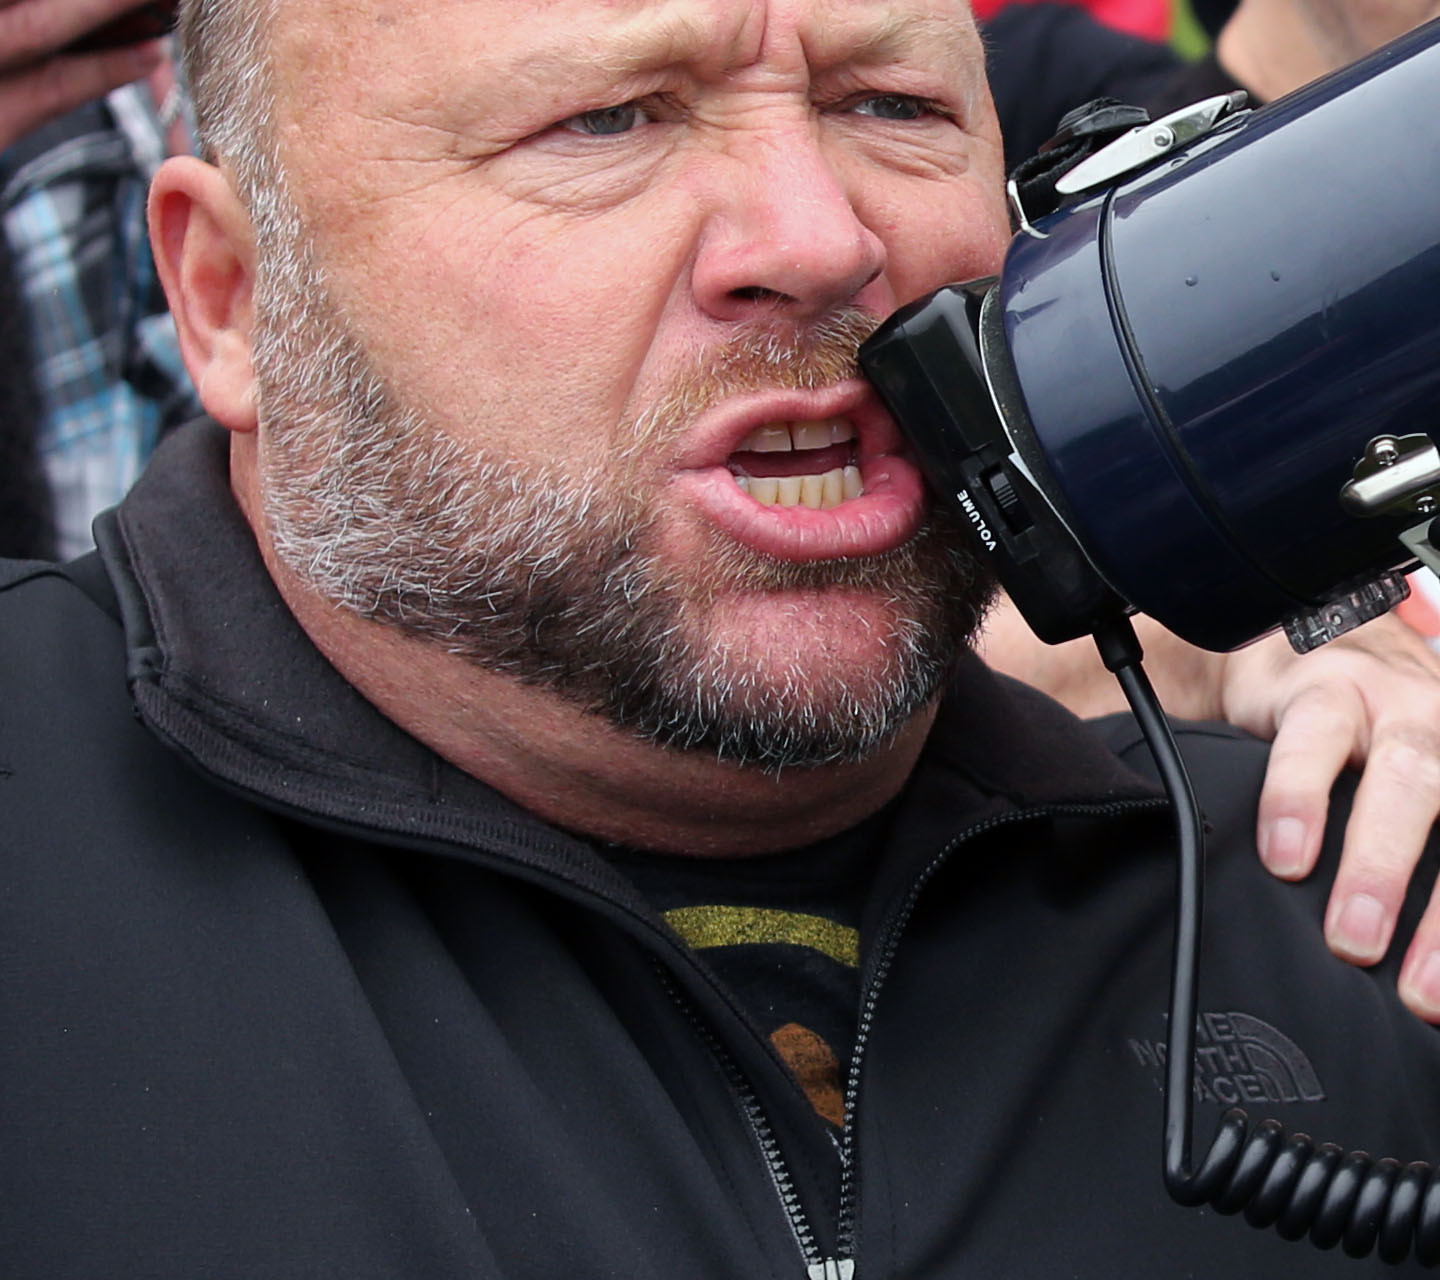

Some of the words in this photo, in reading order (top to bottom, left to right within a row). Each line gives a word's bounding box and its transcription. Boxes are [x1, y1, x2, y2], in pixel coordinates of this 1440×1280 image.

[956, 489, 997, 551] VOLUME
[1128, 1038, 1248, 1073] NOTH
[1153, 1073, 1269, 1104] ACE
